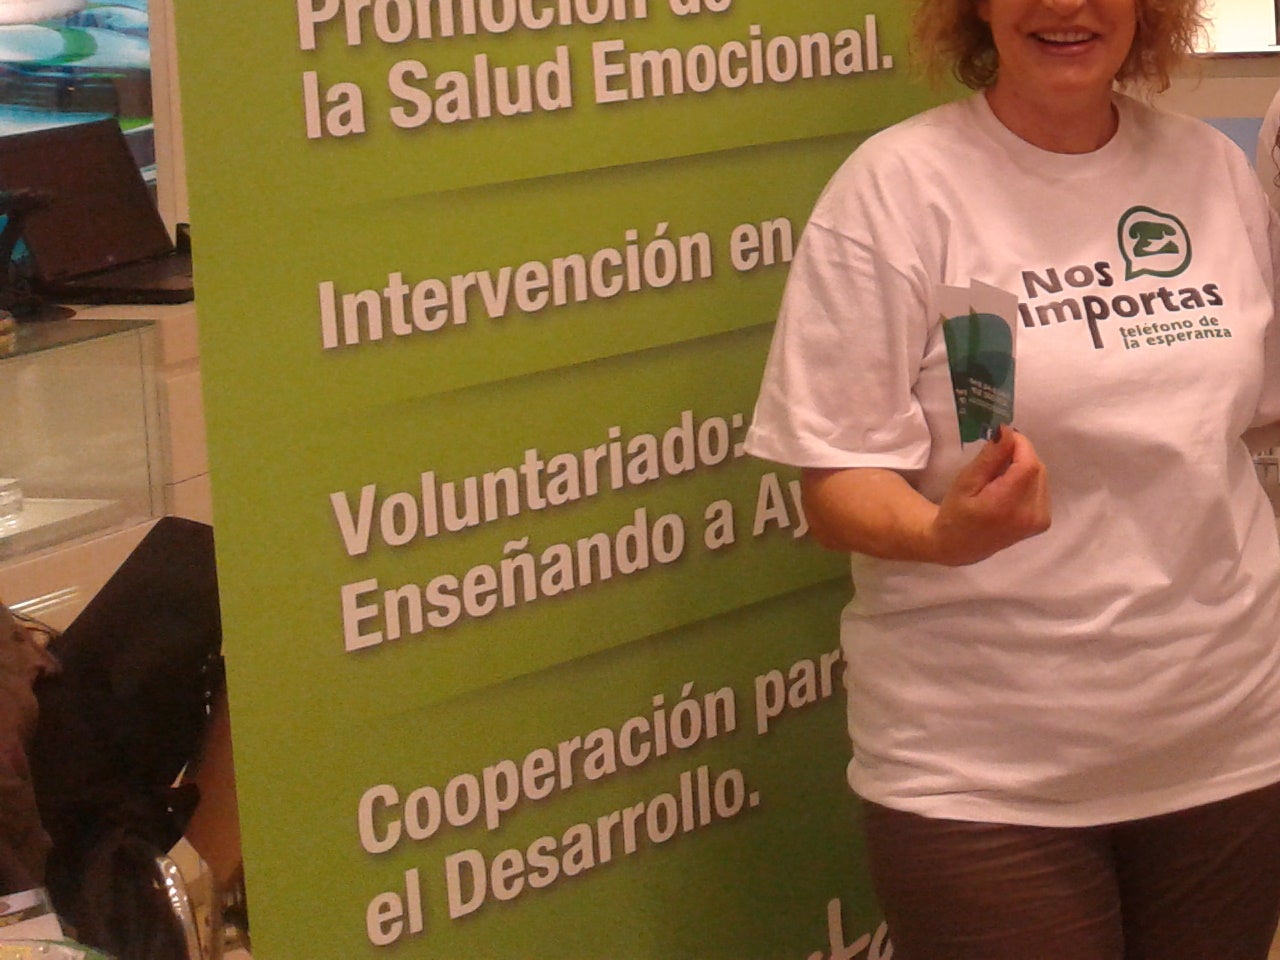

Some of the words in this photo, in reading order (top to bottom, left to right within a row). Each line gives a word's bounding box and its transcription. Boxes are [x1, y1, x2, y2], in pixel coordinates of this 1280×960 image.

[303, 71, 365, 139] la
[388, 45, 572, 129] Salud
[592, 14, 893, 103] Emocional.
[319, 222, 712, 349] Intervención
[729, 216, 795, 272] en
[1018, 283, 1223, 349] Importas
[1022, 261, 1114, 299] Nos
[1119, 319, 1193, 338] teléfono
[1199, 315, 1220, 328] de
[1124, 334, 1140, 350] la
[1146, 328, 1232, 347] esperanza
[330, 410, 745, 557] Voluntariado:
[340, 507, 685, 653] Enseñando
[704, 498, 734, 551] a
[358, 681, 736, 854] Cooperación
[755, 648, 848, 734] par
[366, 868, 423, 947] el
[446, 765, 760, 919] Desarrollo.
